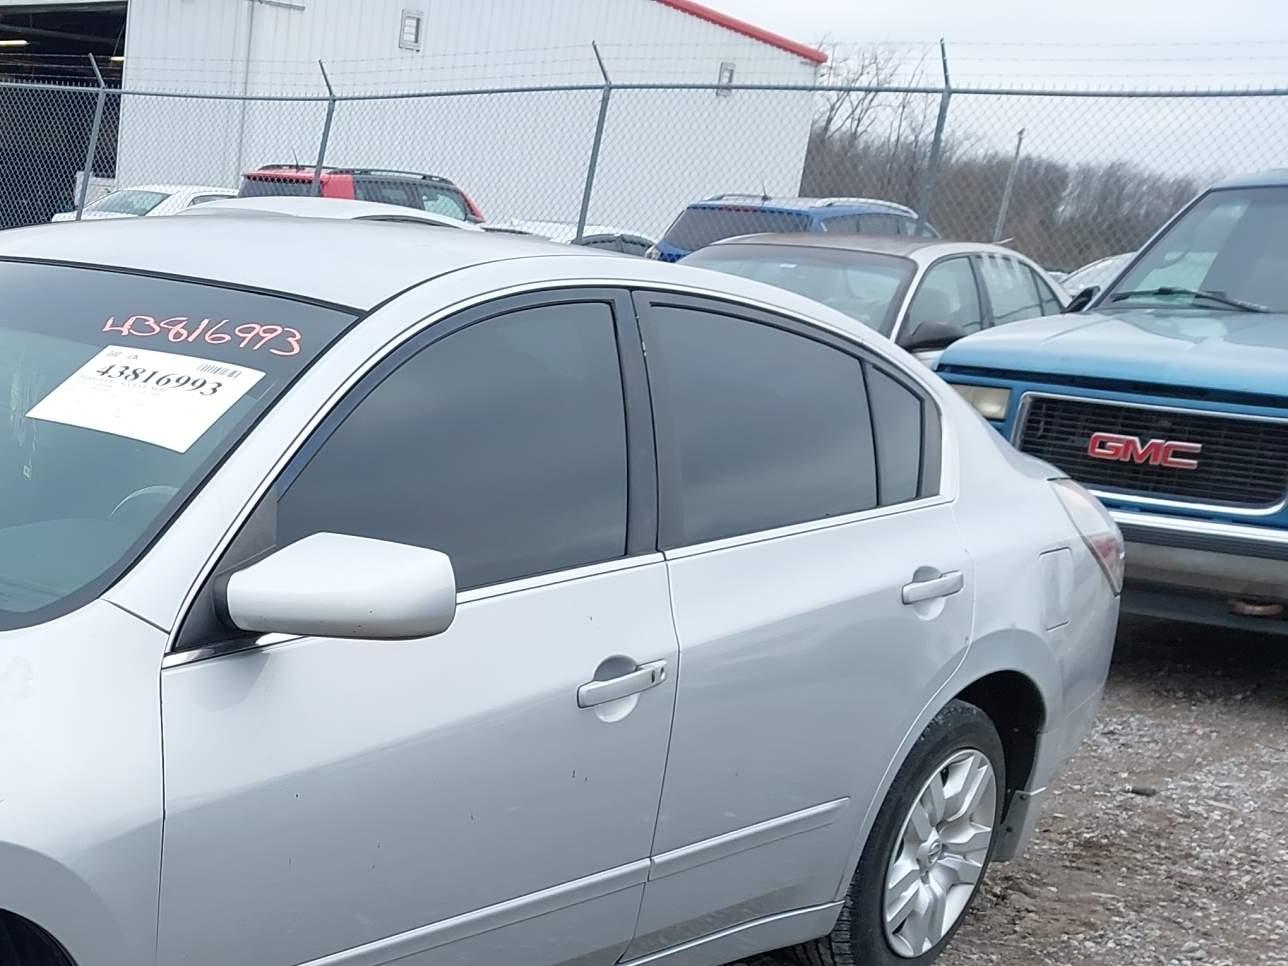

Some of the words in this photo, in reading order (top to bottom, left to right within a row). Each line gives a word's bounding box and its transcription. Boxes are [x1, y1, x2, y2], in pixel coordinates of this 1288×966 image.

[102, 315, 302, 356] 43816993
[96, 363, 223, 396] 43816993
[1088, 431, 1203, 470] GMC
